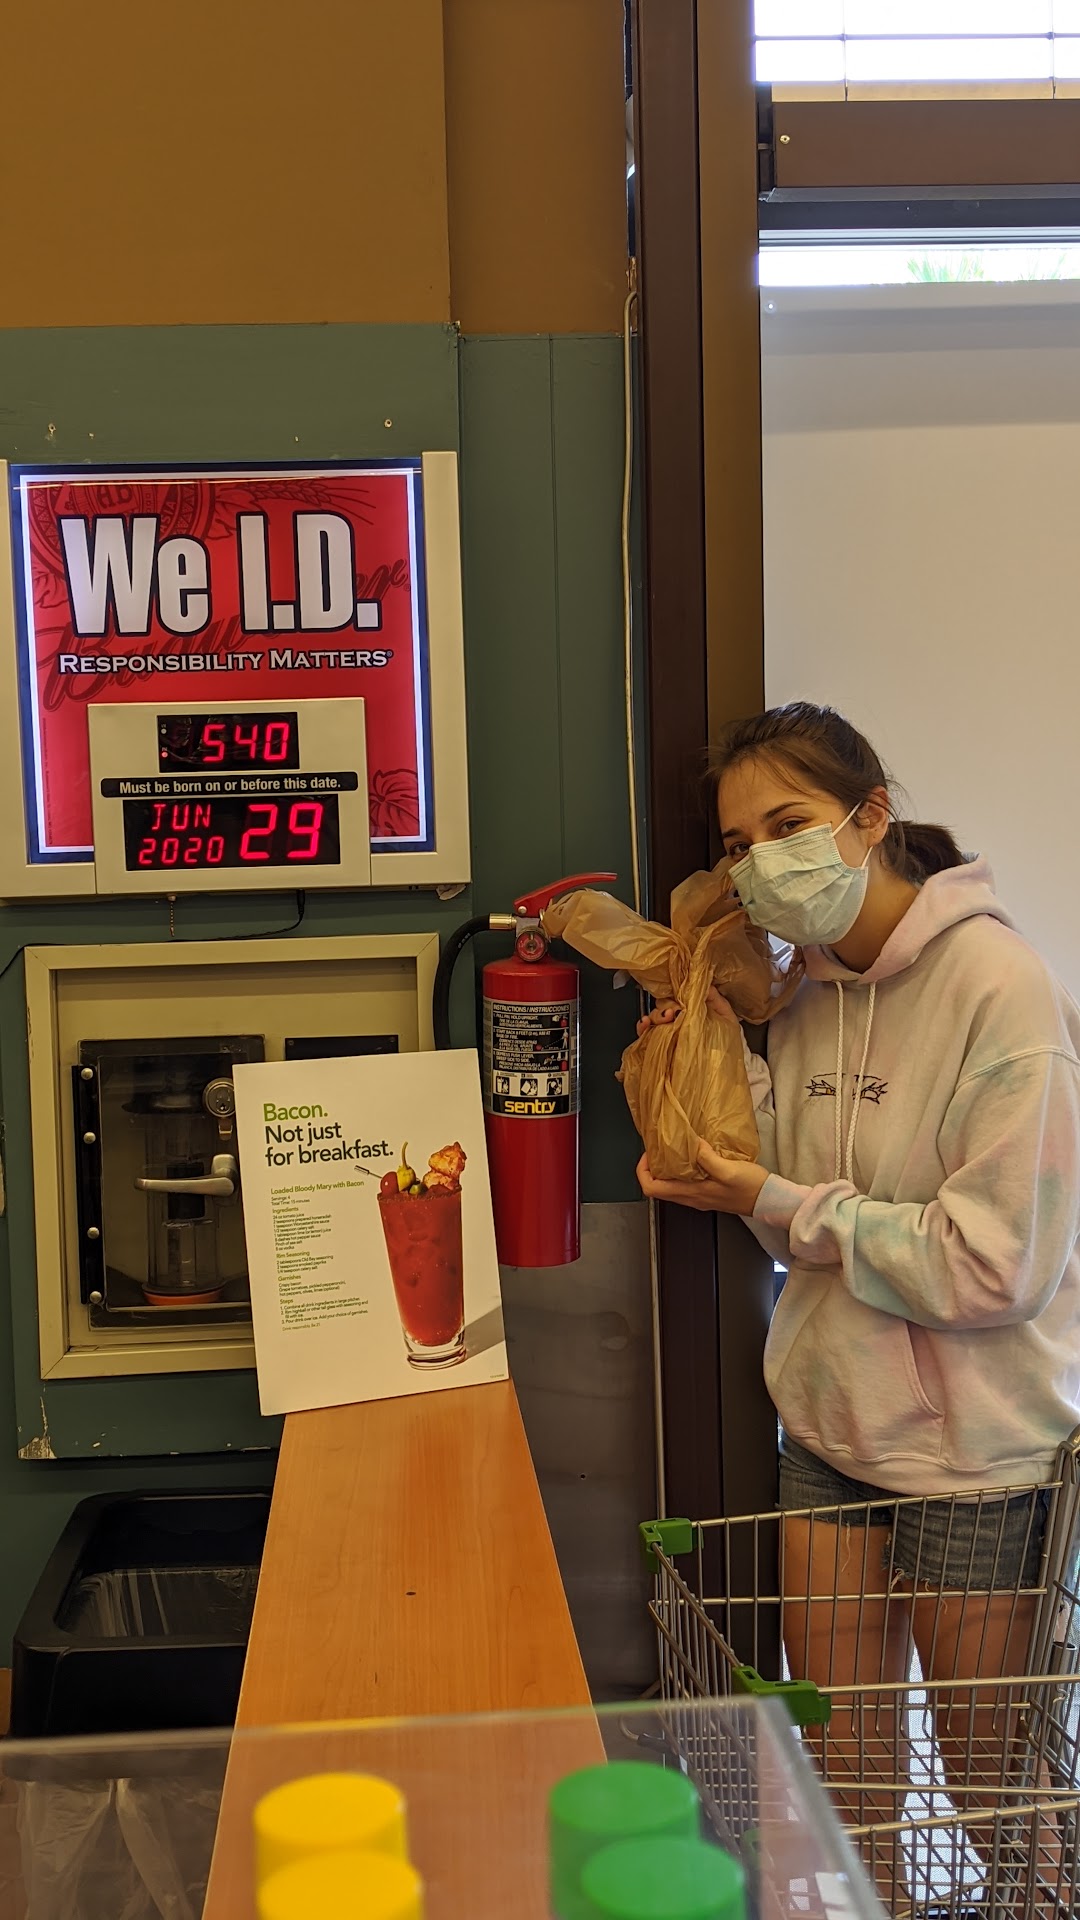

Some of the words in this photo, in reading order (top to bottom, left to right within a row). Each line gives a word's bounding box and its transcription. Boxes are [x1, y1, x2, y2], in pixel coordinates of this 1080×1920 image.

[59, 515, 209, 635] We
[237, 512, 381, 630] I.D.
[59, 652, 262, 674] RESPONSIBILITY
[120, 782, 151, 794] Must
[155, 781, 170, 793] be
[173, 780, 201, 792] born
[206, 782, 220, 791] on
[224, 781, 237, 791] or
[241, 778, 280, 791] before
[283, 778, 307, 789] this
[311, 777, 341, 788] date.
[152, 804, 211, 830] JUN
[240, 803, 323, 860] 29
[138, 836, 225, 865] 2020
[263, 1103, 328, 1121] Bacon.
[504, 1099, 556, 1113] sentry
[265, 1124, 304, 1144] Not
[307, 1122, 342, 1146] just
[265, 1146, 294, 1167] for
[298, 1139, 394, 1164] breakfast.
[271, 1187, 294, 1195] Loaded
[295, 1184, 315, 1193] Bloody
[316, 1183, 332, 1191] Mary
[346, 1180, 364, 1188] Bacon
